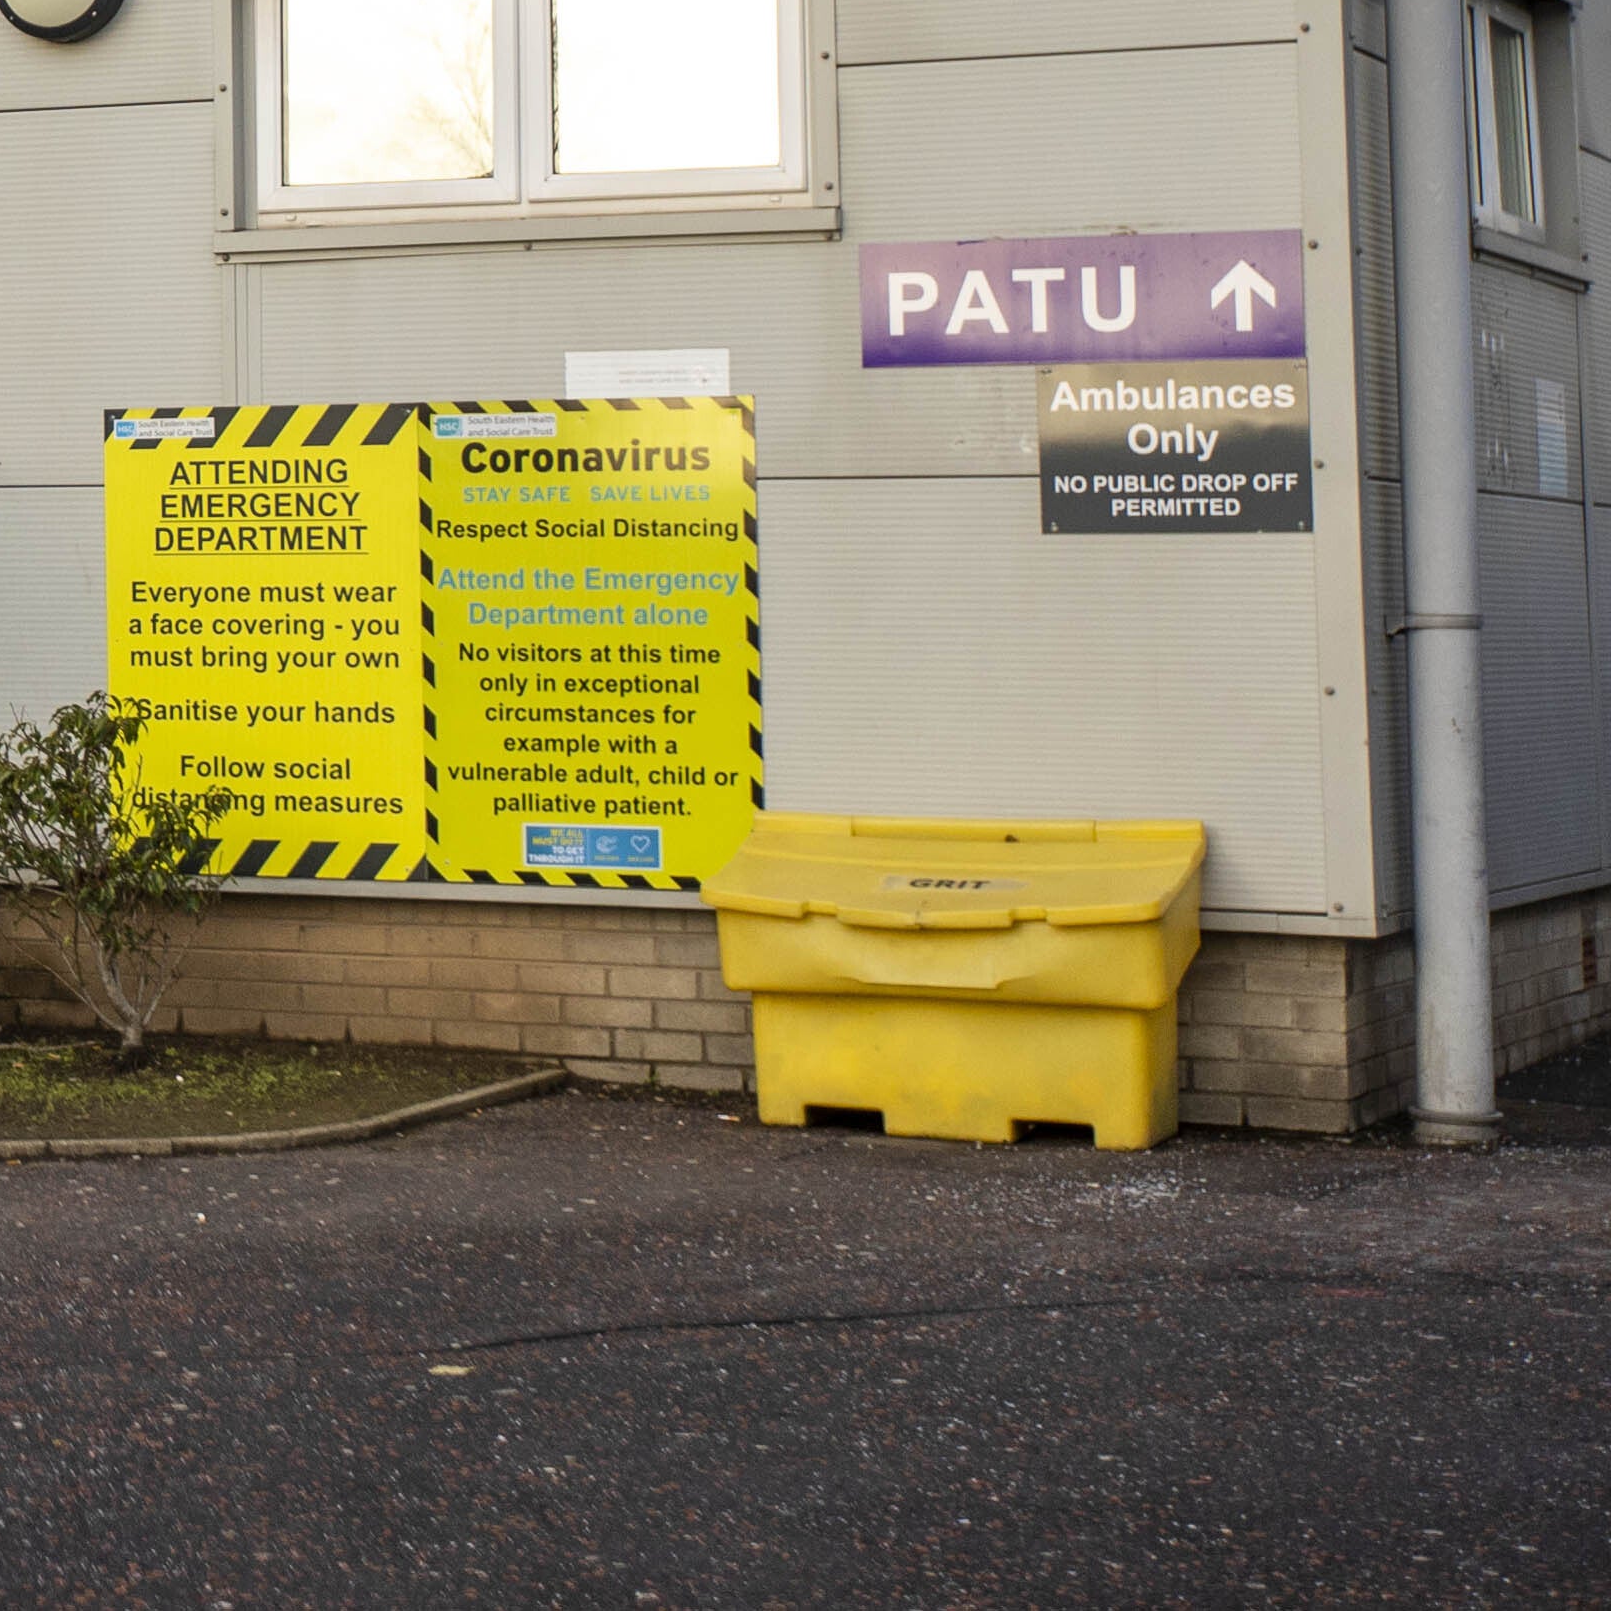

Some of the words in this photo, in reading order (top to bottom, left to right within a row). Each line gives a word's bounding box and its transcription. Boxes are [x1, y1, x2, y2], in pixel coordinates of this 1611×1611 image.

[887, 264, 1137, 338] PATU
[1050, 379, 1296, 414] Ambulances
[467, 416, 493, 425] South
[494, 415, 526, 424] Eastern
[527, 415, 555, 423] Health
[467, 428, 484, 437] and
[486, 427, 511, 436] Social
[511, 428, 531, 436] Care
[531, 427, 553, 435] Trust
[1127, 422, 1219, 462] Only
[461, 438, 711, 473] Coronavirus
[169, 458, 348, 485] ATTENDING
[1054, 475, 1087, 494] NO
[1092, 474, 1176, 494] PUBLIC
[1181, 473, 1248, 493] DROP
[1252, 473, 1298, 492] OFF
[160, 492, 361, 518] EMERGENCY
[463, 486, 511, 502] STAY
[519, 485, 571, 502] SAFE
[590, 485, 643, 501] SAVE
[650, 484, 711, 501] LIVES
[1110, 497, 1241, 517] PERMITTED
[155, 526, 368, 552] DEPARTMENT
[436, 519, 528, 542] Respect
[535, 518, 605, 538] Social
[613, 517, 739, 541] Distancing
[438, 567, 524, 590] Attend
[534, 568, 575, 590] the
[584, 568, 740, 596] Emergency
[131, 581, 251, 608] Everyone
[260, 582, 325, 602] must
[333, 586, 397, 602] wear
[129, 618, 142, 635] a
[150, 613, 203, 635] face
[212, 613, 325, 641] covering
[351, 618, 400, 641] you
[468, 601, 625, 630] Department
[633, 603, 709, 626] alone
[130, 646, 193, 667] must
[202, 646, 268, 673] bring
[277, 650, 336, 673] your
[345, 650, 400, 668] own
[458, 643, 489, 662] No
[497, 642, 582, 662] visitors
[590, 646, 611, 663] at
[618, 643, 662, 663] this
[669, 643, 721, 664] time
[479, 674, 528, 697] only
[536, 674, 556, 693] in
[564, 674, 700, 697] exceptional
[137, 698, 238, 721] Sanitise
[247, 704, 306, 727] your
[314, 700, 396, 723] hands
[484, 703, 655, 724] circumstances
[663, 704, 697, 724] for
[503, 734, 600, 757] example
[607, 735, 657, 754] with
[665, 739, 678, 754] a
[180, 755, 265, 778] Follow
[274, 757, 351, 780] social
[447, 762, 568, 784] vulnerable
[575, 764, 641, 787] adult,
[647, 765, 706, 786] child
[713, 771, 739, 786] or
[132, 787, 266, 816] distanng
[275, 793, 404, 814] measures
[493, 793, 596, 815] palliative
[604, 795, 692, 818] patient.
[909, 877, 990, 890] GRIT
